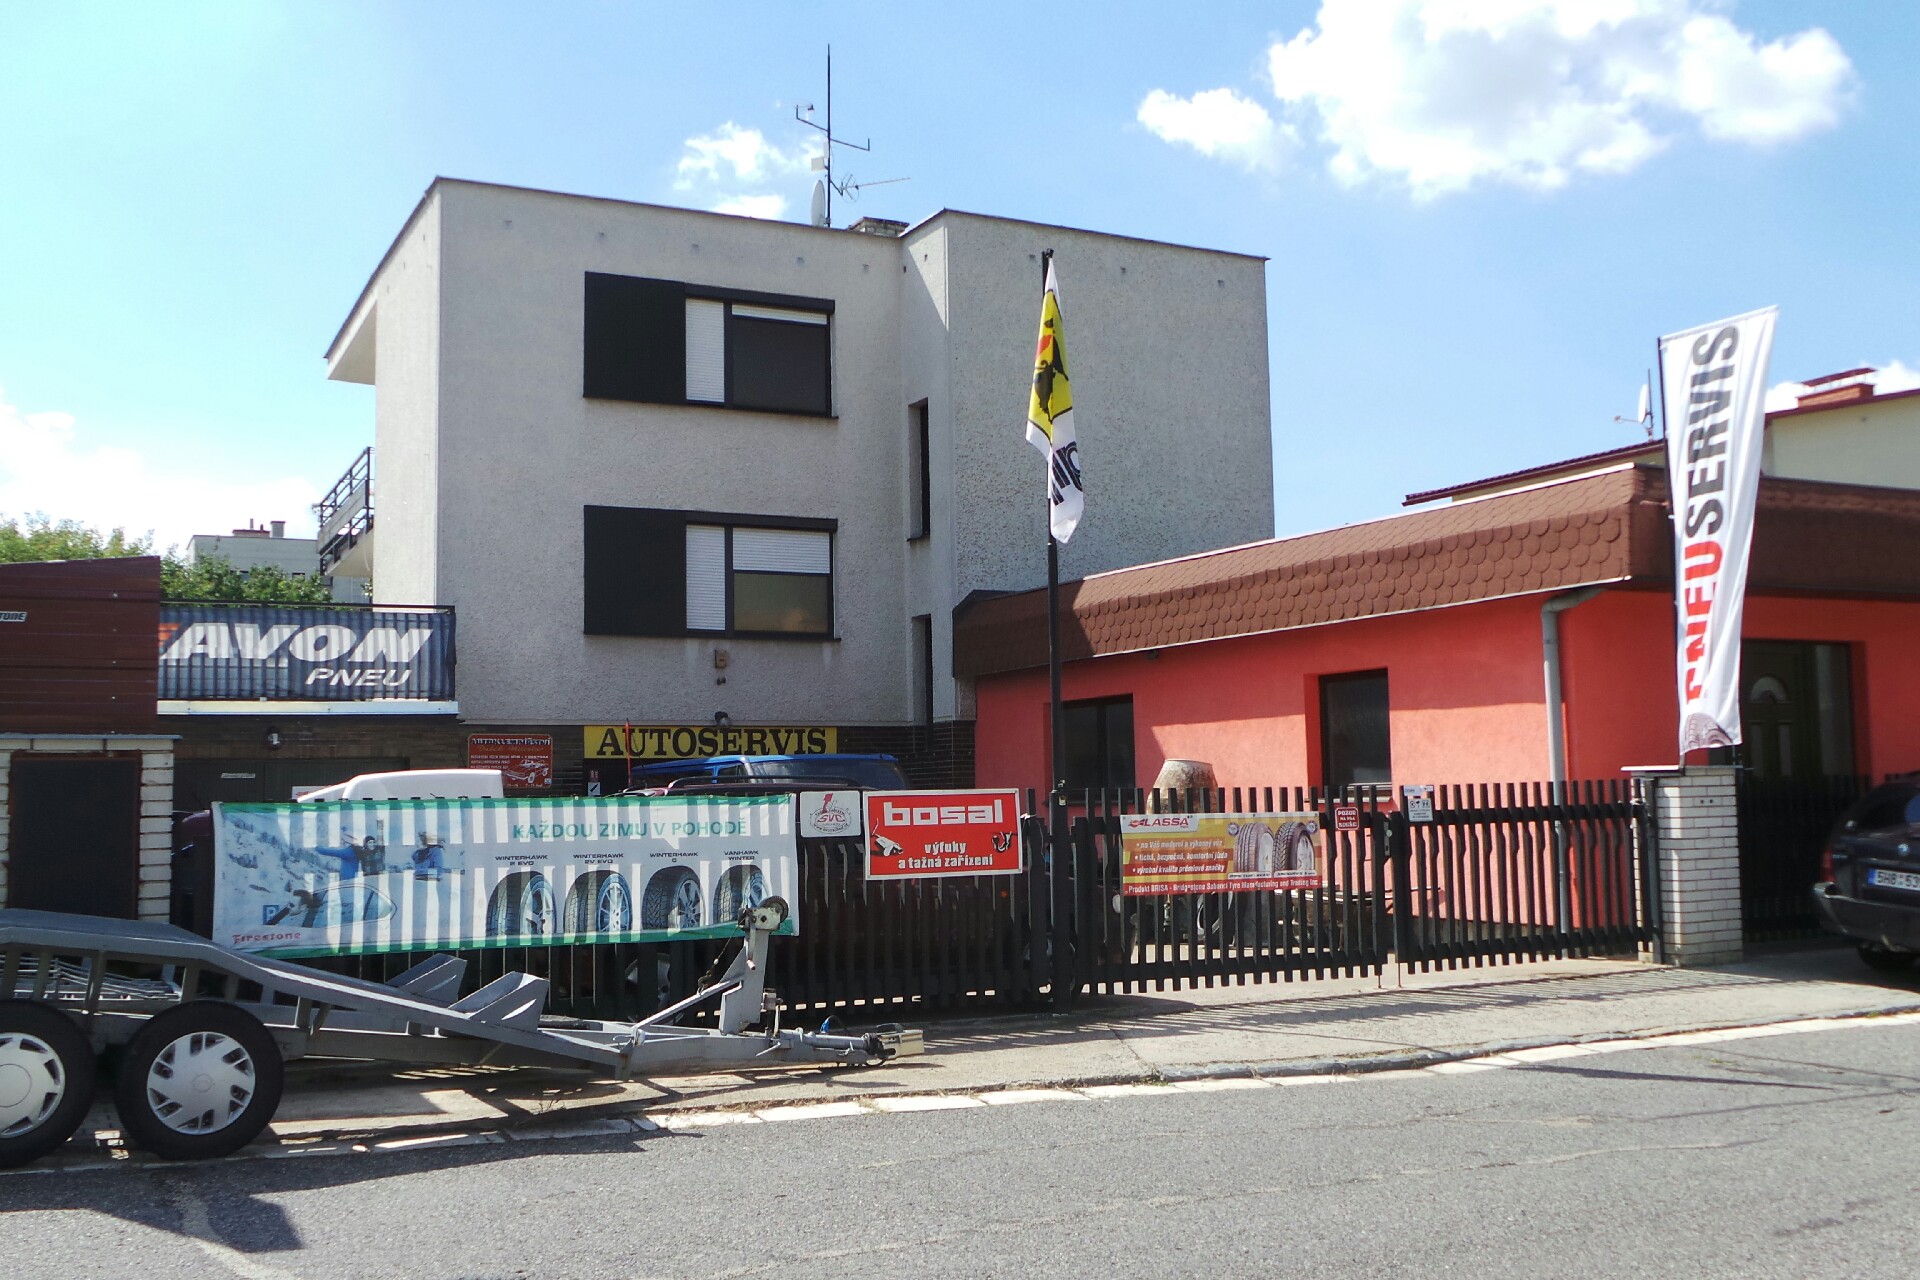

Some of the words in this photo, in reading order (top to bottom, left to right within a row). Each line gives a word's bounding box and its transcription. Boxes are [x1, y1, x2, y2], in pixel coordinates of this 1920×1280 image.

[161, 622, 434, 663] AVON
[305, 667, 412, 687] PNEU
[597, 726, 827, 757] AUTOSERVIS
[883, 799, 1003, 826] bosal
[513, 820, 593, 839] KAŽDOU
[599, 822, 647, 838] ZIMU
[652, 822, 666, 836] V
[671, 818, 747, 836] POHODĚ
[1144, 817, 1189, 827] LASSA
[924, 840, 967, 855] výfuky
[898, 858, 905, 869] a
[908, 856, 942, 869] tažná
[944, 853, 993, 868] zařízení
[1151, 884, 1168, 892] BRISA
[1229, 882, 1240, 890] Tyre
[232, 932, 302, 944] Firestone
